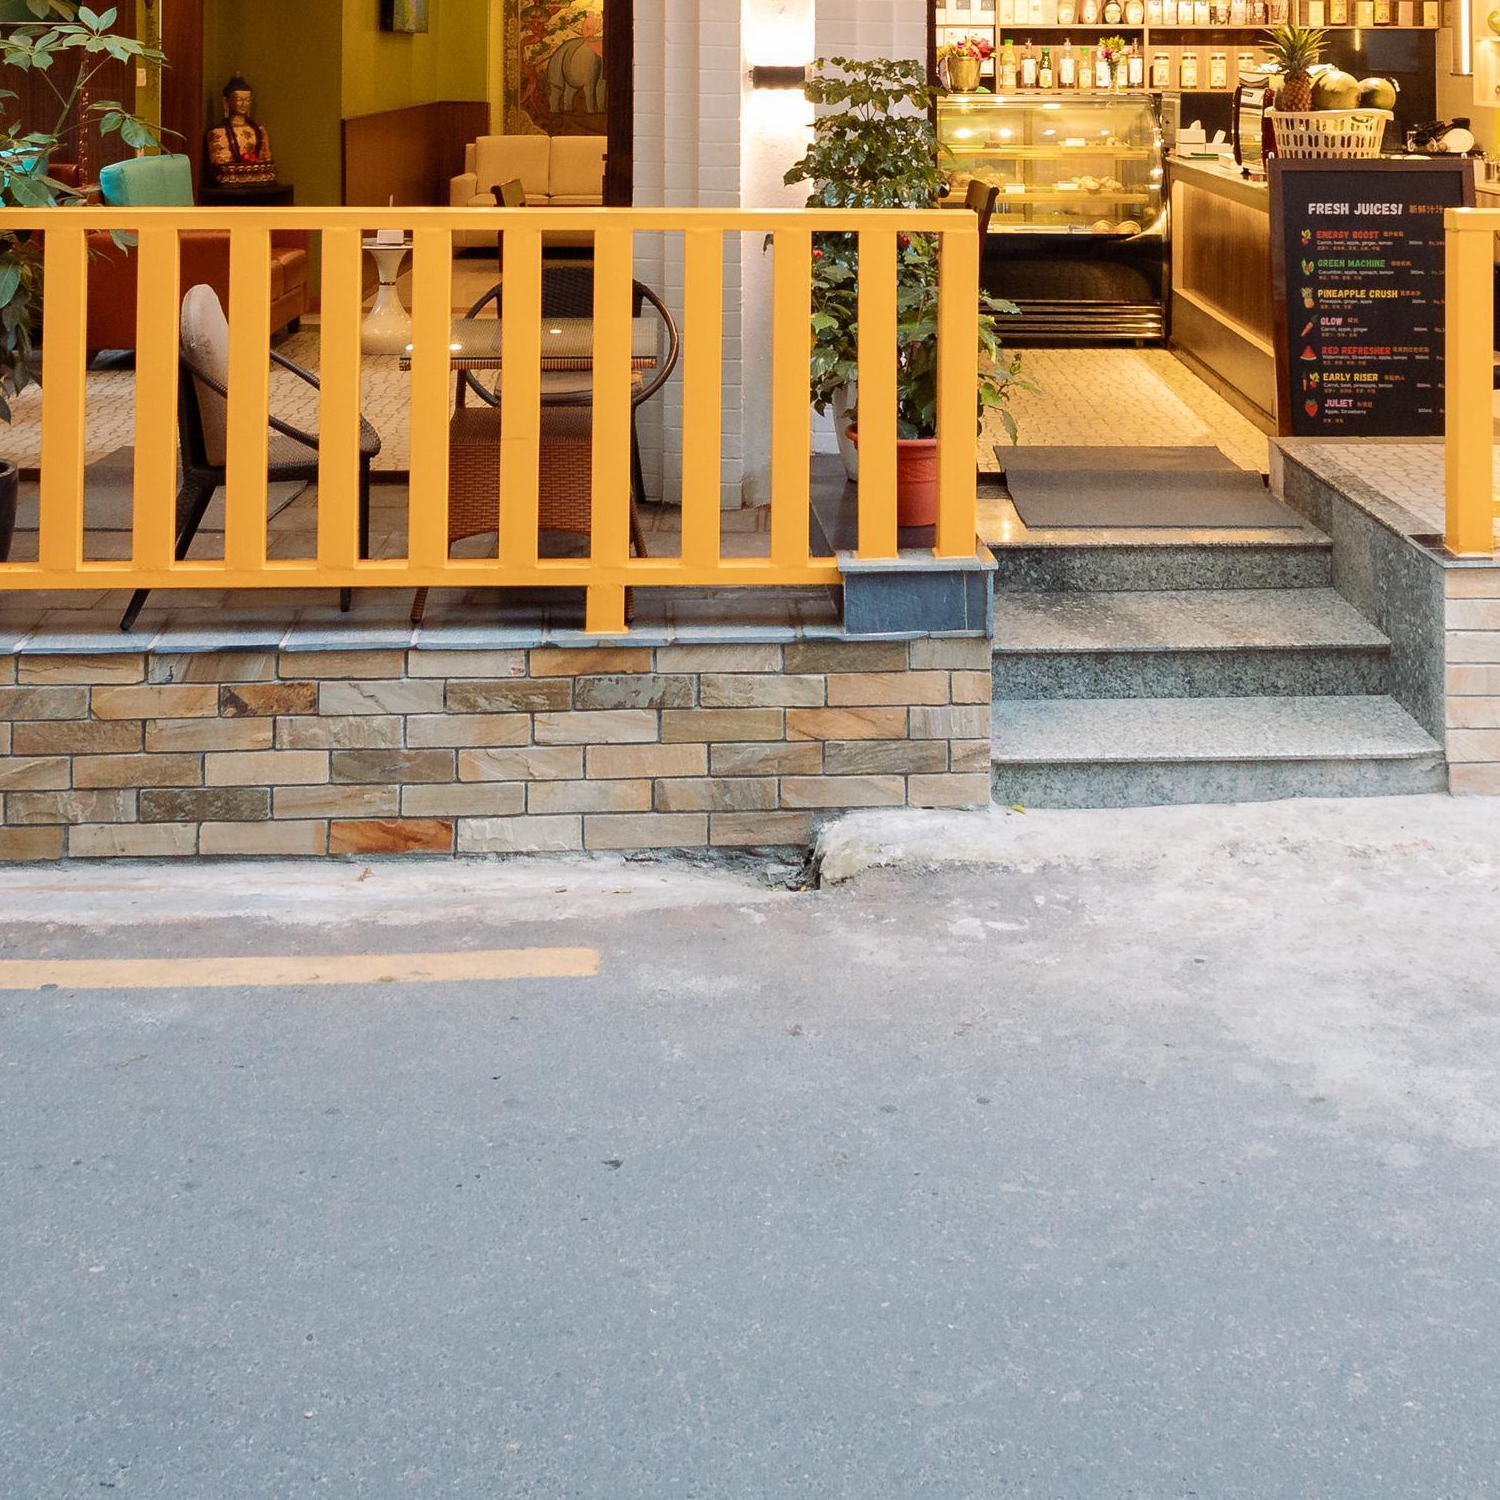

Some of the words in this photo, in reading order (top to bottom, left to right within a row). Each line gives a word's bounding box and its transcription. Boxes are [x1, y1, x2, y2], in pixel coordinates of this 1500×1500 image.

[1308, 203, 1349, 214] FRESH
[1354, 203, 1403, 214] JUICES!
[1316, 231, 1349, 239] ENERGY
[1352, 231, 1379, 239] BOOST
[1317, 289, 1366, 298] PINEAPPLE
[1368, 289, 1398, 298] CRUSH
[1320, 317, 1342, 325] GLOW
[1321, 346, 1339, 354] RED
[1341, 346, 1391, 354] REFRESHER
[1323, 373, 1351, 381] EARLY
[1353, 373, 1378, 381] RISER
[1324, 399, 1353, 407] JULIET
